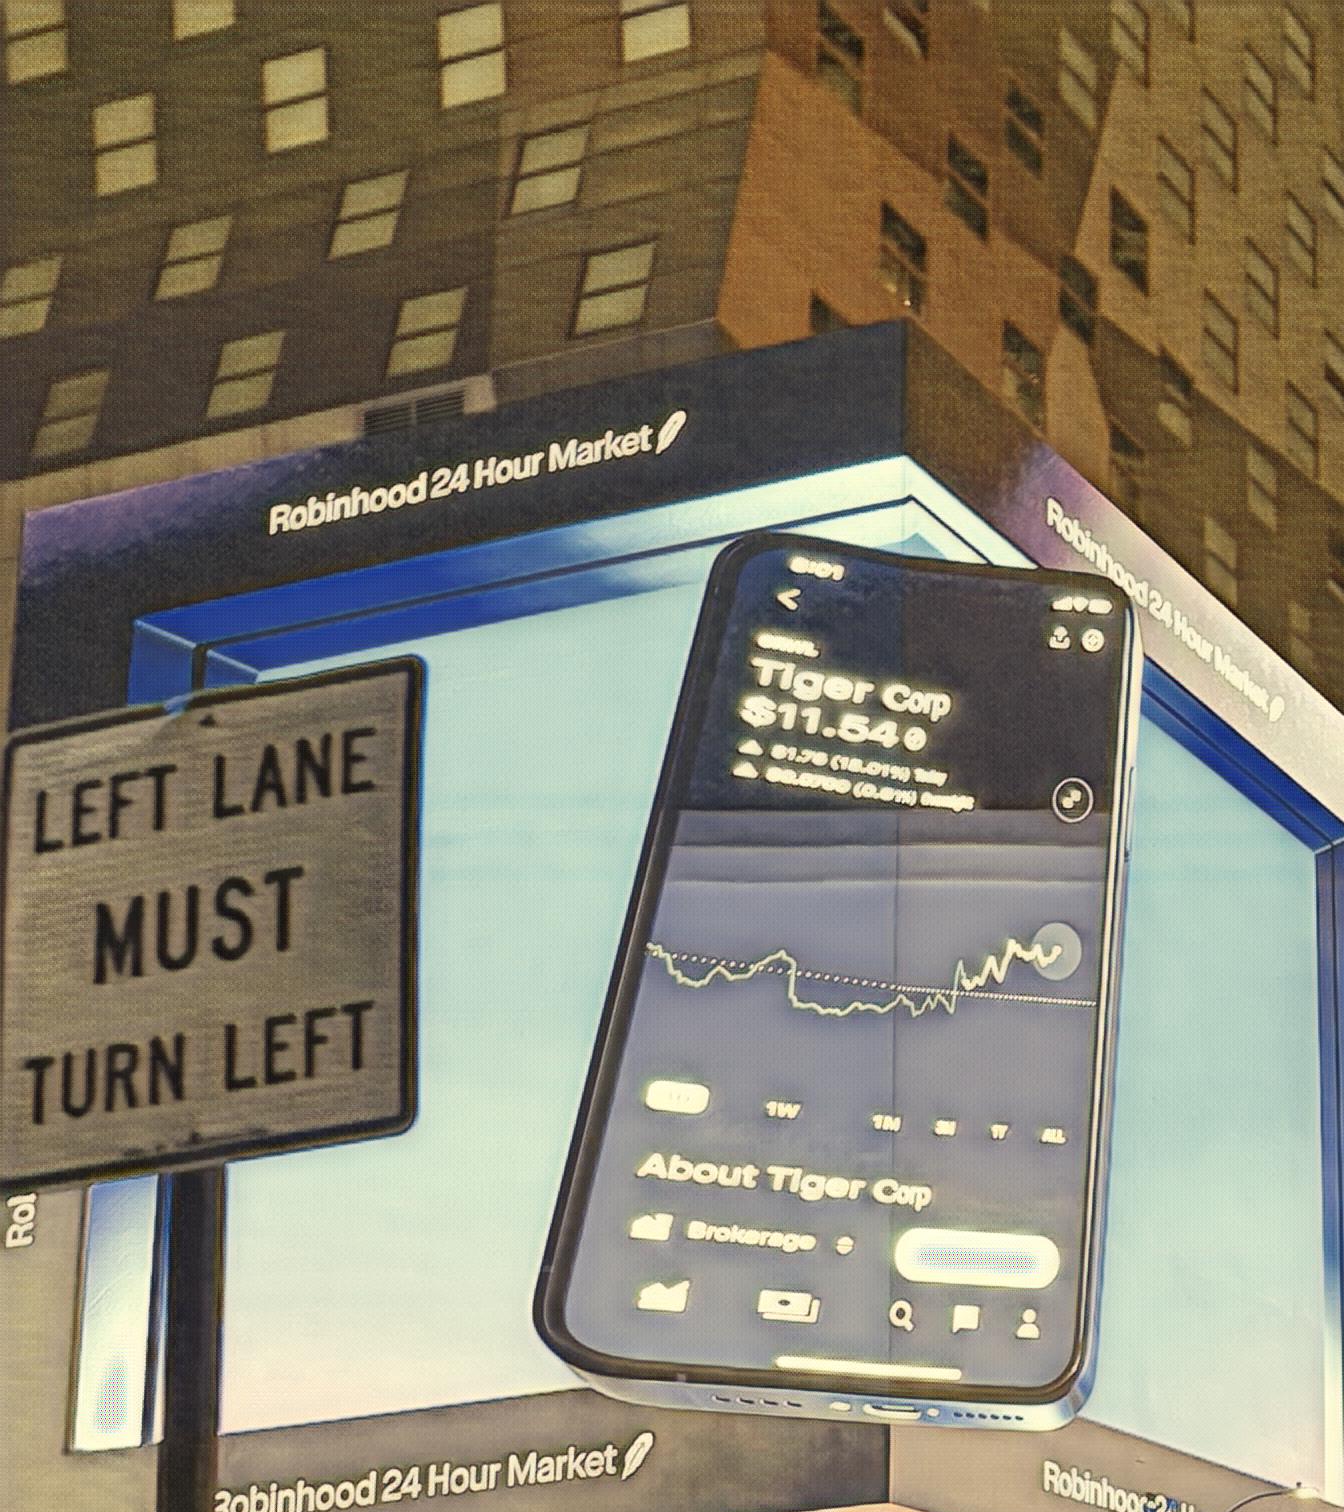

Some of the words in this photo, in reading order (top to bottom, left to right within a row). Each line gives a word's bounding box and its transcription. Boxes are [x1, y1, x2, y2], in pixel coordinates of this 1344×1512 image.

[268, 472, 429, 536] Robinhood
[432, 468, 470, 498] 24
[473, 452, 544, 490] Hour
[548, 424, 653, 474] Market
[1045, 496, 1151, 609] Robinhood
[1149, 588, 1174, 629] 24
[1172, 609, 1215, 664] Hour
[1212, 645, 1270, 714] Market
[738, 694, 900, 749] $11.54
[750, 656, 876, 705] Tiger
[880, 682, 953, 723] Corp
[35, 763, 178, 855] LEFT
[211, 726, 378, 819] LANE
[92, 865, 305, 985] MUST
[23, 1031, 187, 1125] TURN
[223, 999, 375, 1092] LEFT
[635, 1151, 761, 1190] About
[871, 1177, 933, 1212] Corp
[686, 1219, 818, 1254] Brokerage
[380, 1465, 424, 1504] 24
[427, 1460, 502, 1498] Hour
[506, 1442, 619, 1488] Market
